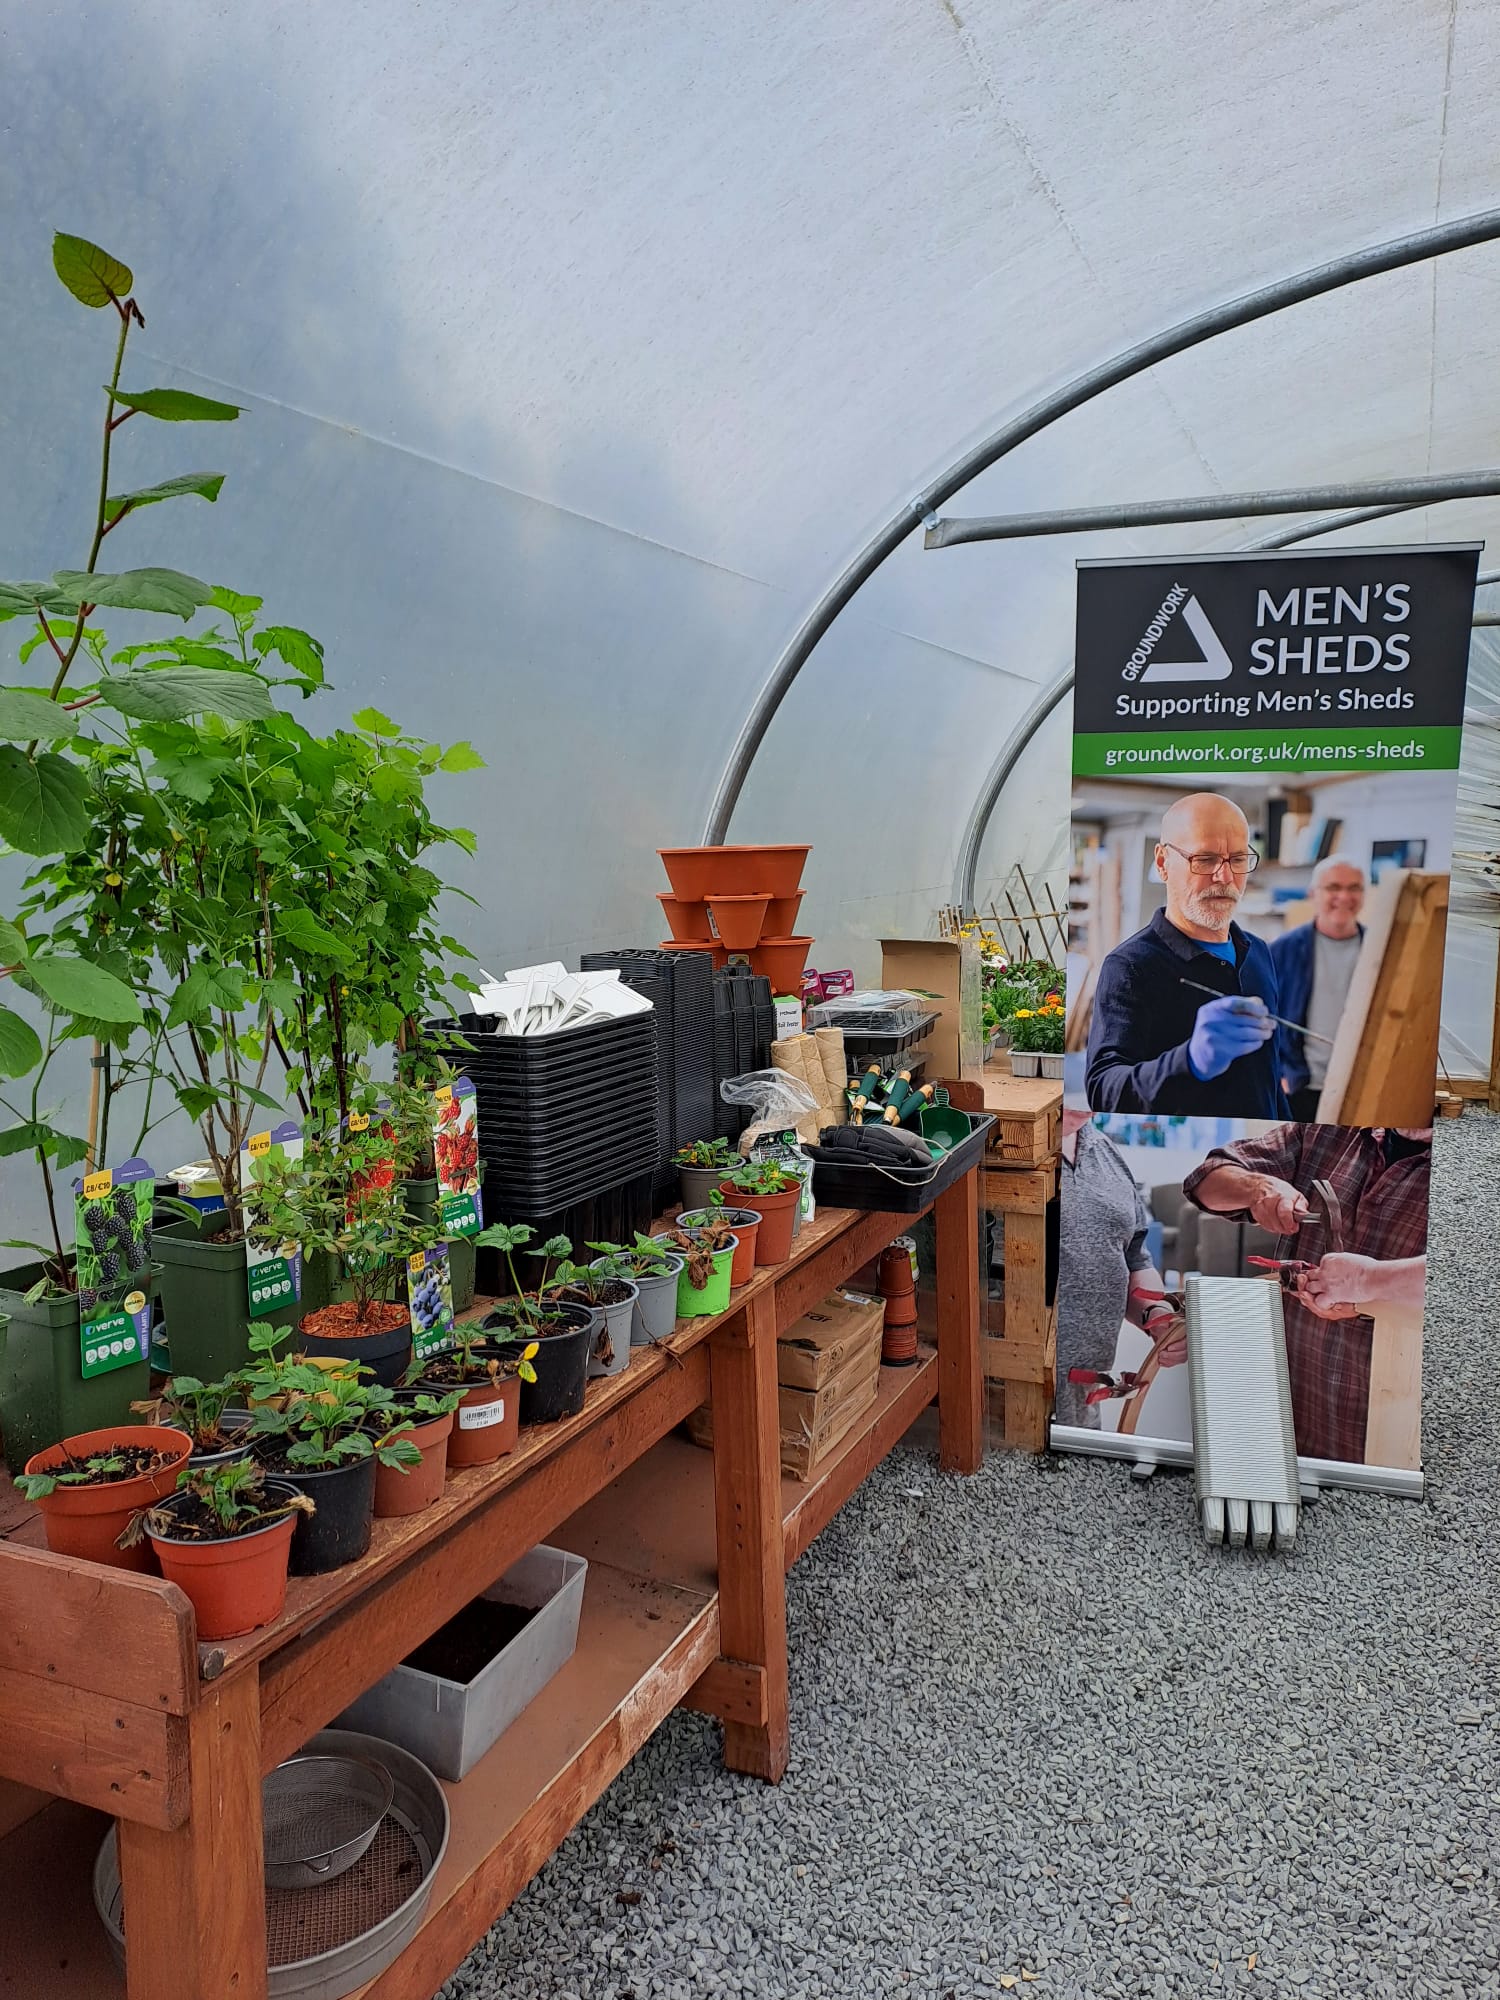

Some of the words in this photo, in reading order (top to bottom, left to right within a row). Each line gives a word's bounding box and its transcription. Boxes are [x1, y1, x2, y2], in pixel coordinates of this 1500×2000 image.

[1256, 582, 1411, 627] MEN’S
[1121, 582, 1189, 682] GROUNDWORK
[1248, 633, 1411, 676] SHEDS
[1115, 692, 1252, 719] Supporting
[1256, 689, 1332, 712] Men’s
[1337, 687, 1415, 710] Sheds
[1105, 740, 1425, 766] groundwork.org.uk/mens-sheds
[259, 1262, 283, 1275] verve
[95, 1317, 125, 1333] verve
[141, 1311, 149, 1333] PLANTS
[141, 1333, 149, 1350] FRUIT
